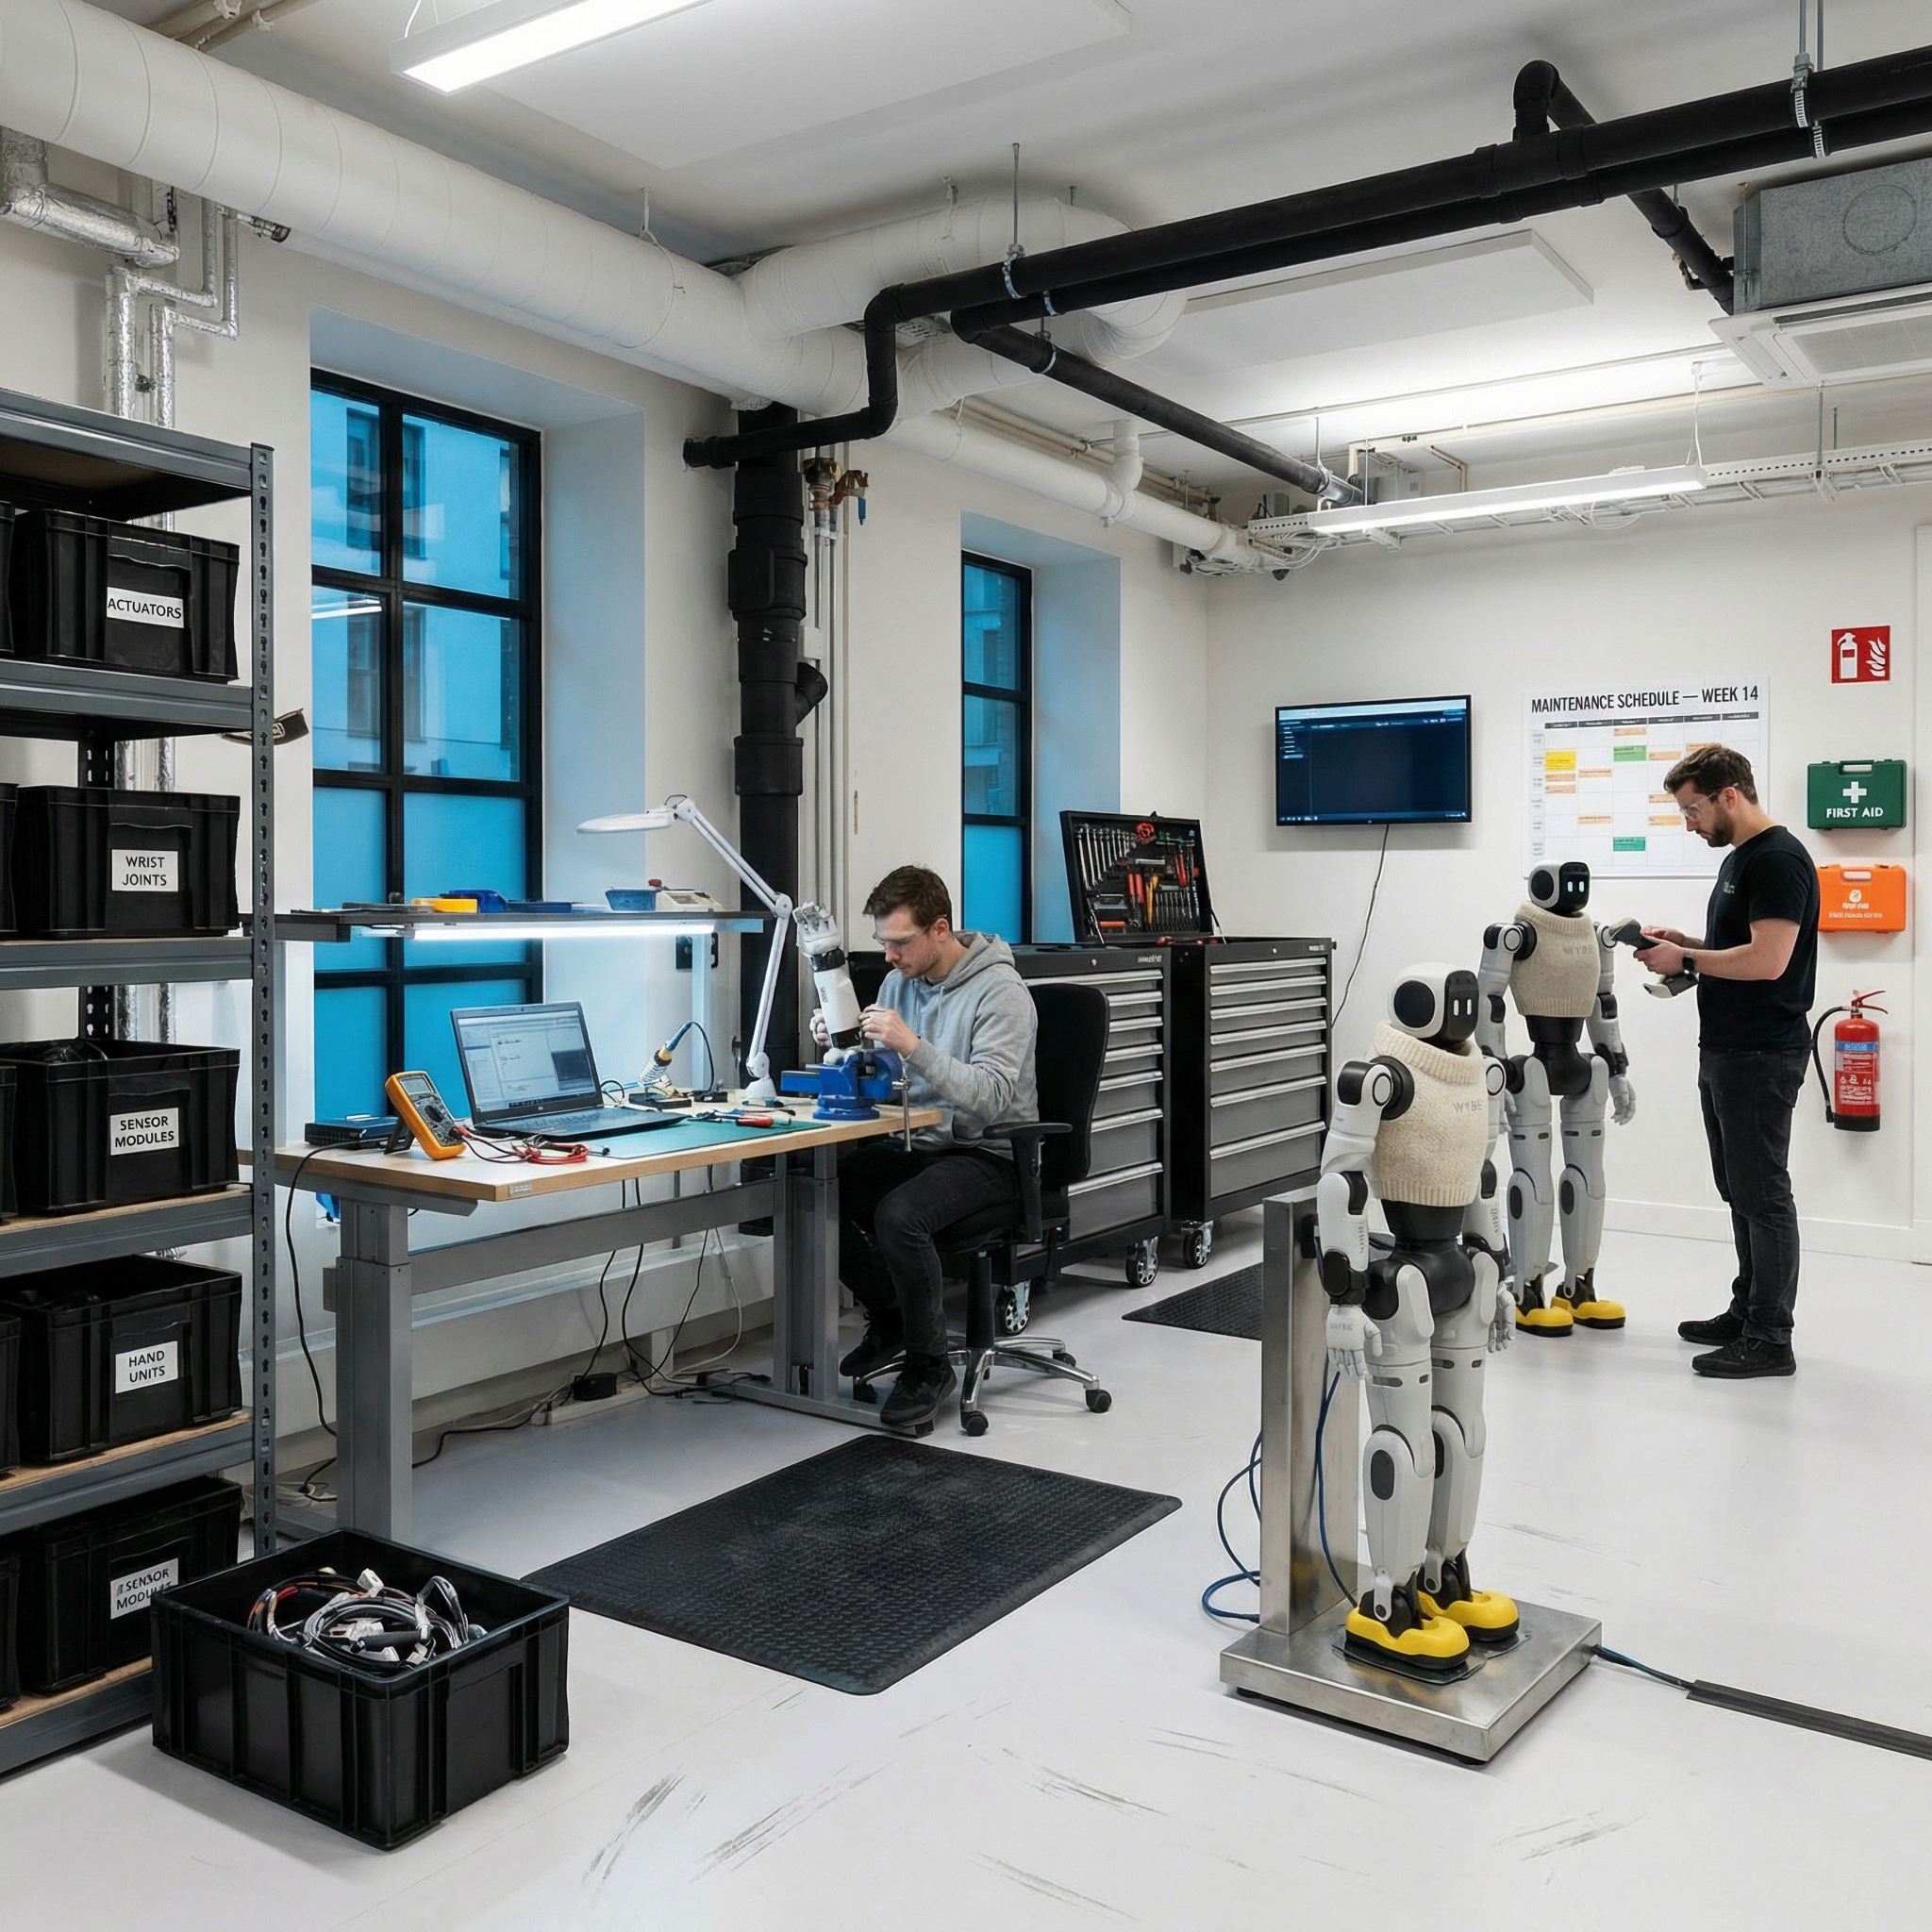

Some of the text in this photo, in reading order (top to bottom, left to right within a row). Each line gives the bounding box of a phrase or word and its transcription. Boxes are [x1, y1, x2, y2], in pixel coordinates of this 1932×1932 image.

[108, 598, 182, 619] ACTUATORS
[1531, 694, 1615, 713] MAINTENANCE
[1617, 690, 1680, 708] SCHEDULE
[1702, 687, 1739, 703] WEEK
[1742, 685, 1758, 701] 14
[1826, 807, 1884, 818] FIRST AID
[125, 856, 165, 868] WRIST
[122, 874, 167, 886] JOINTS
[120, 1116, 169, 1131] SENSOR
[115, 1131, 175, 1148] MODULES
[129, 1350, 165, 1368] HAND
[129, 1365, 165, 1383] UNITS
